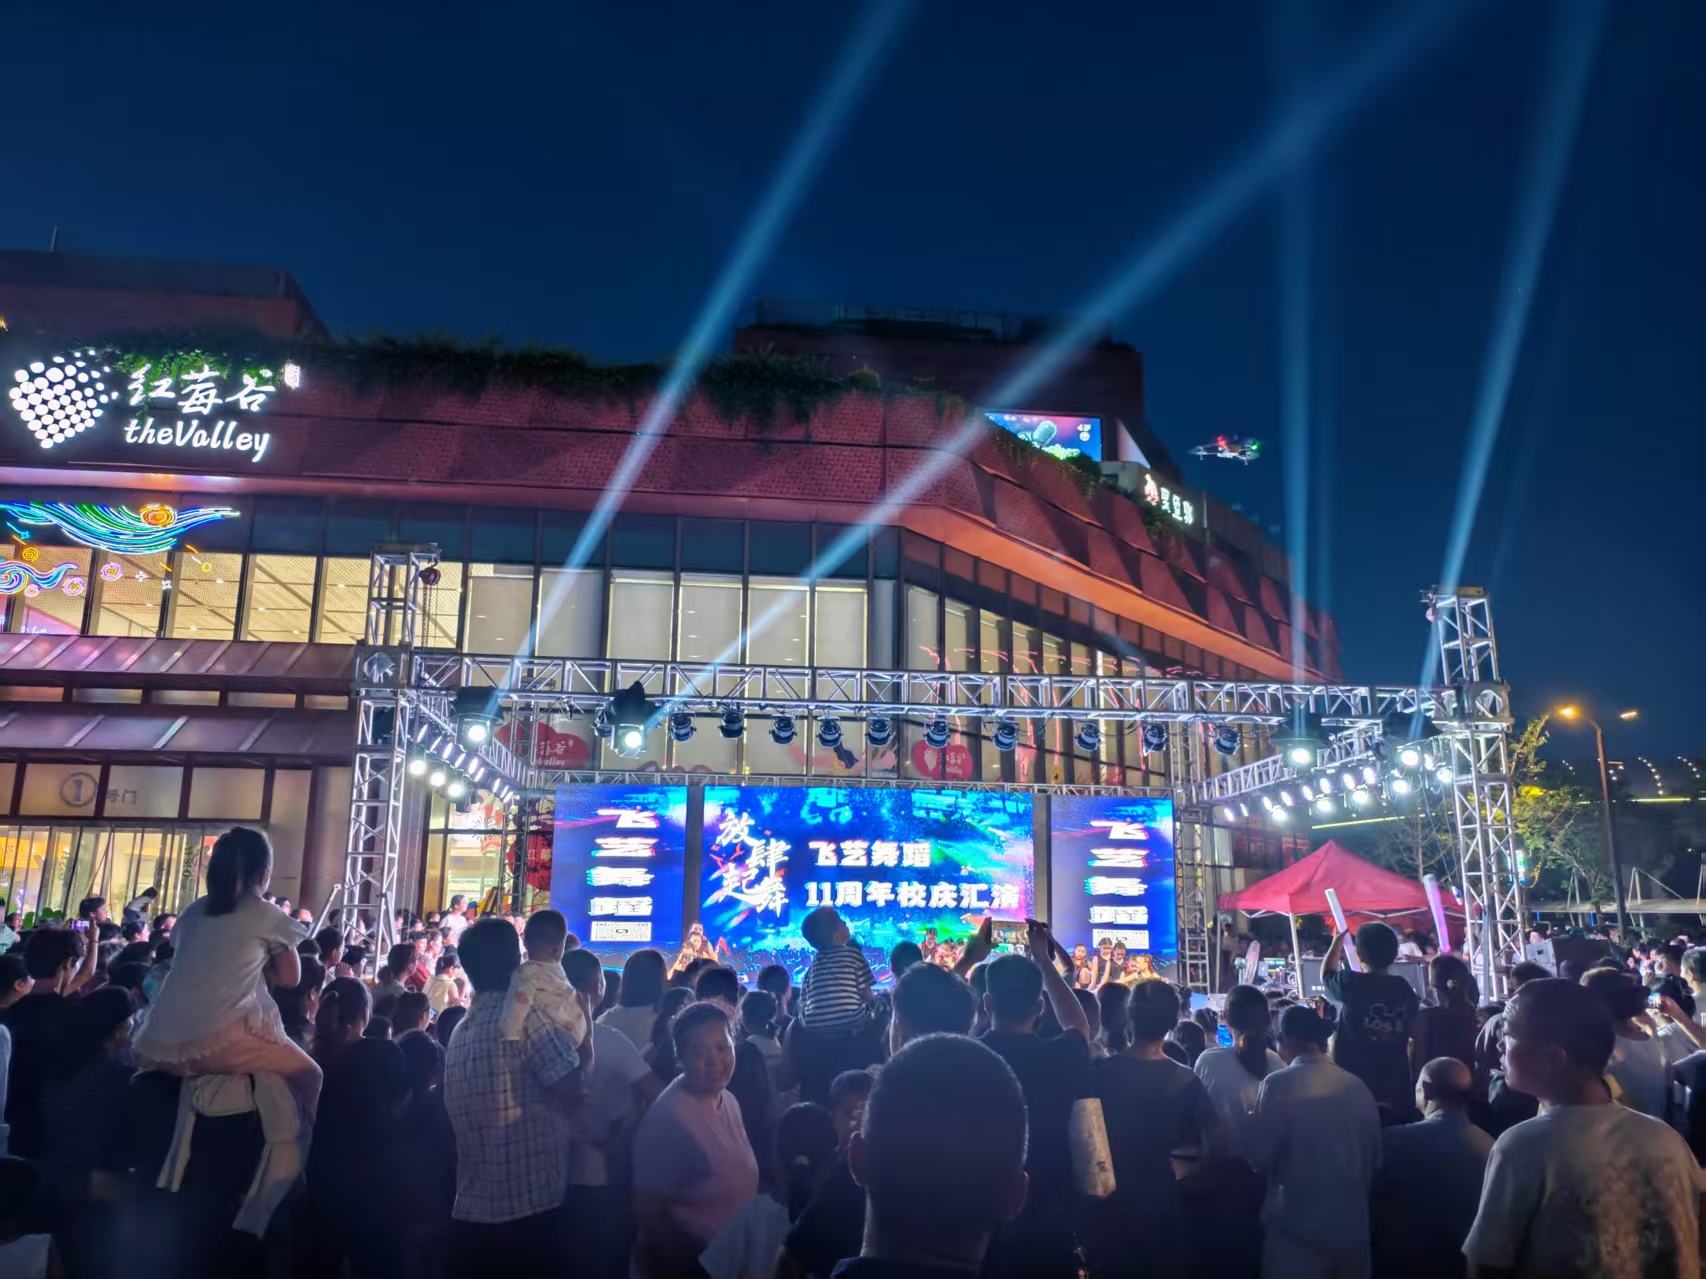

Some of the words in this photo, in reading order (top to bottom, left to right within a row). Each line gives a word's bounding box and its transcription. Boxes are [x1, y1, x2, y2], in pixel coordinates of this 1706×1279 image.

[127, 363, 277, 416] 红莓谷
[123, 417, 272, 463] theValley
[808, 840, 932, 868] 飞艺舞蹈
[804, 881, 1021, 909] 11周年校庆汇演
